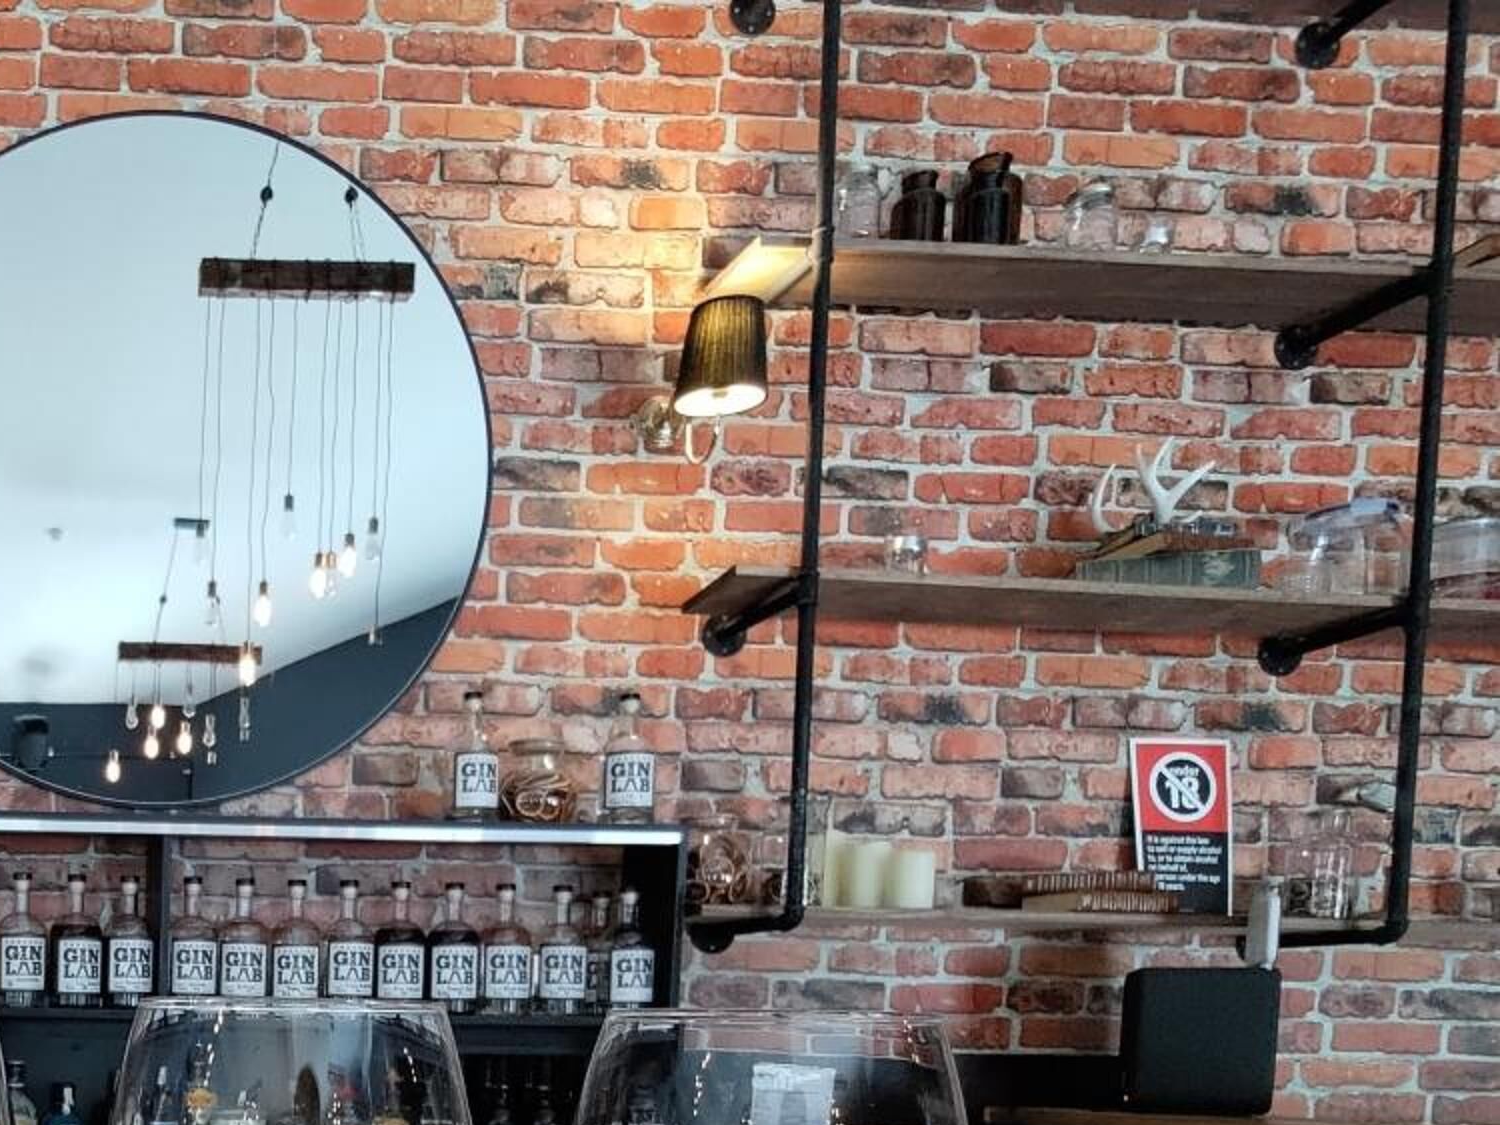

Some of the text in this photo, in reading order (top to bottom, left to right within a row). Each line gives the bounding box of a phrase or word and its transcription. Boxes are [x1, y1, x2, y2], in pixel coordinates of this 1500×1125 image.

[462, 763, 496, 777] GIN
[611, 763, 648, 777] GIN
[611, 779, 648, 793] LAB
[1165, 777, 1199, 809] 18
[5, 946, 42, 961] GIN
[64, 948, 100, 963] GIN
[114, 948, 150, 963] GIN
[177, 949, 213, 964] GIN
[226, 951, 263, 966] GIN
[278, 953, 315, 969] GIN
[333, 951, 371, 966] GIN
[382, 953, 420, 968] GIN
[5, 961, 42, 977] LAB
[436, 955, 474, 969] GIN
[491, 955, 528, 969] GIN
[545, 954, 582, 969] GIN
[617, 958, 652, 972] GIN
[64, 963, 100, 979] LAB
[114, 963, 150, 979] LAB
[177, 965, 213, 980] LAB
[226, 967, 263, 982] LAB
[278, 970, 315, 985] LAB
[333, 967, 371, 981] LAB
[382, 970, 420, 985] LAB
[436, 970, 474, 985] LAB
[491, 970, 528, 985] LAB
[545, 970, 582, 985] LAB
